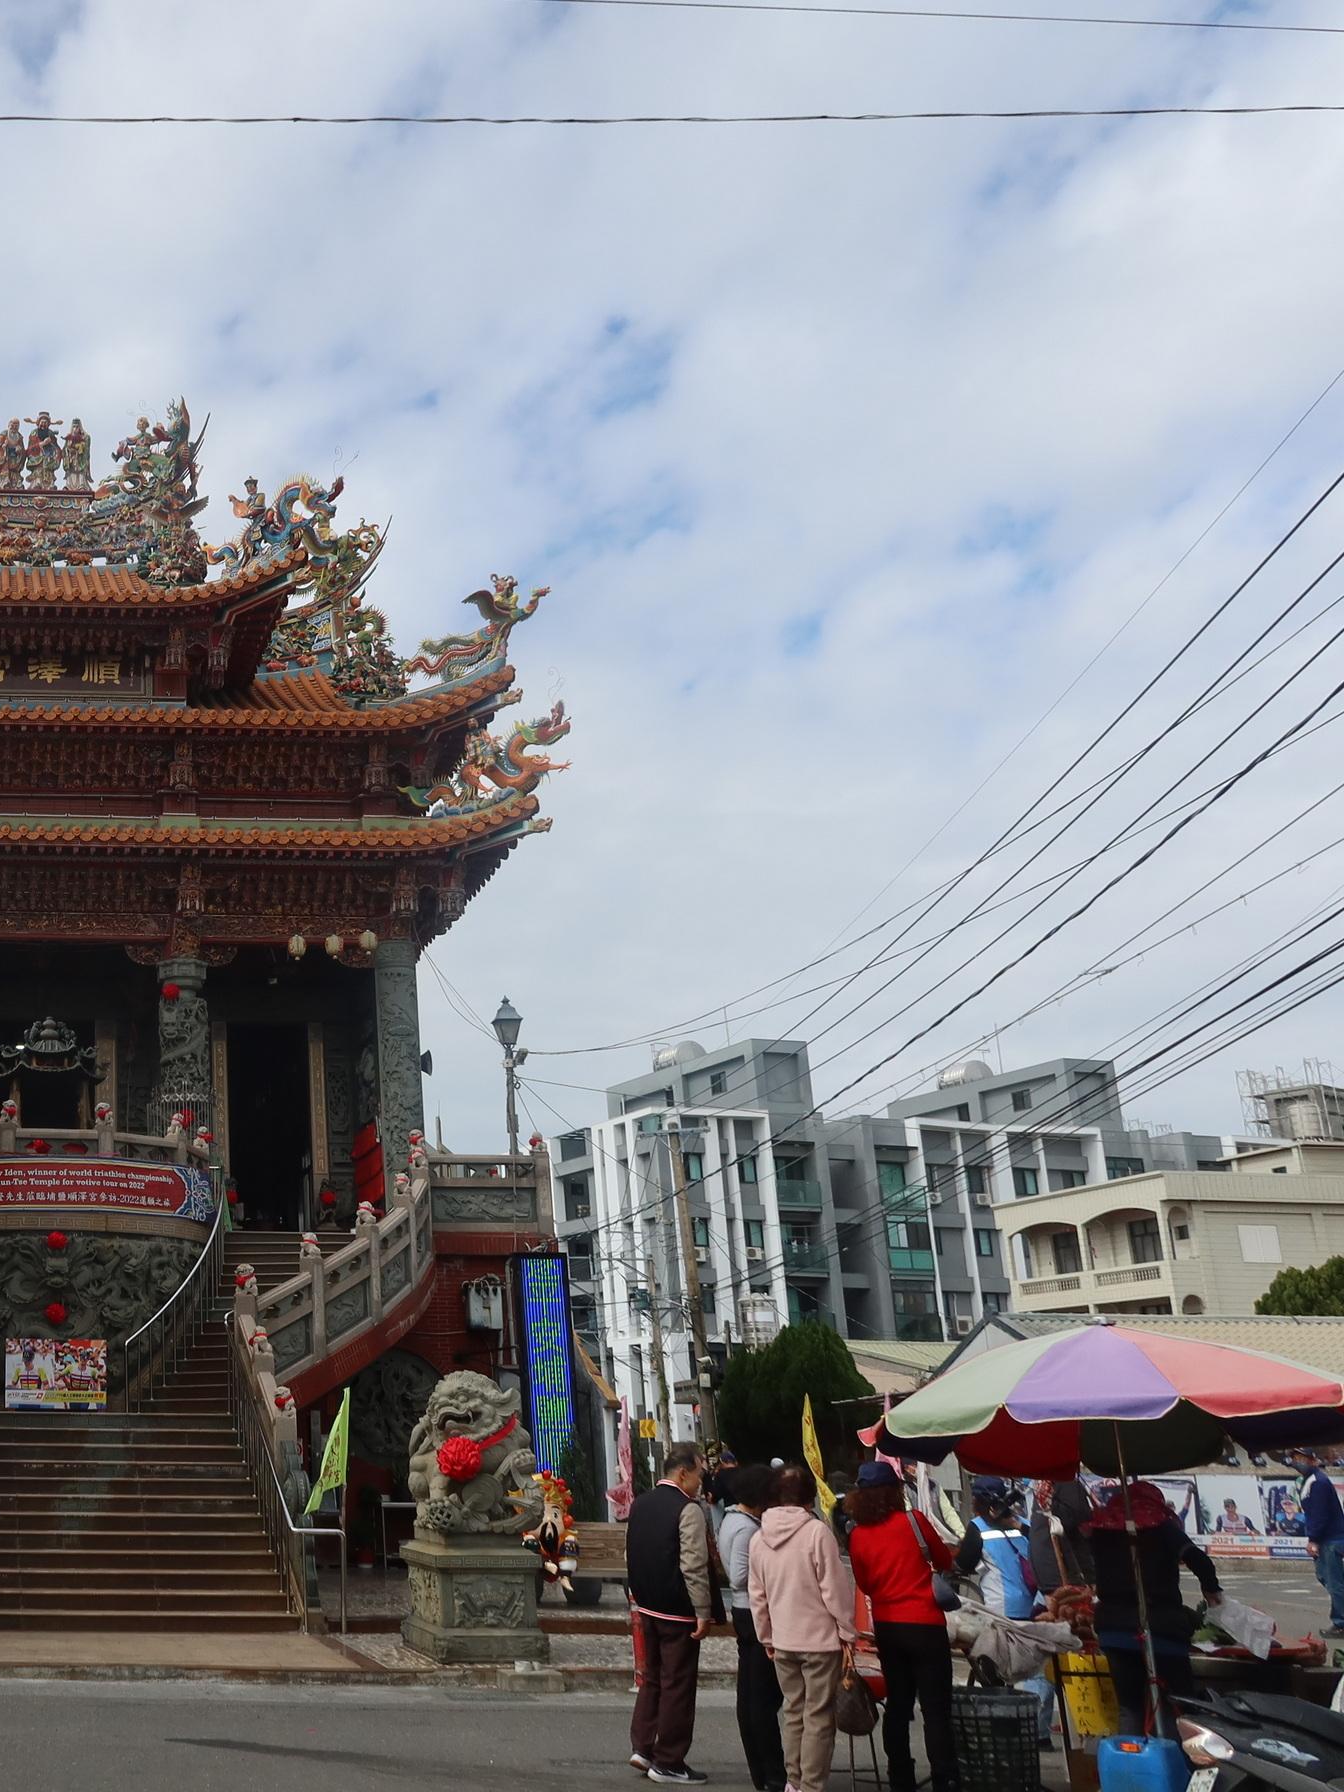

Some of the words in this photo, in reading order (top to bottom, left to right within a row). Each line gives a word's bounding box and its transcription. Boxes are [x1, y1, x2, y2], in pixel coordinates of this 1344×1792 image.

[4, 1168, 26, 1177] Iden,
[27, 1168, 57, 1177] winner
[59, 1168, 67, 1176] of
[68, 1168, 92, 1177] world
[94, 1168, 126, 1179] triathlon
[28, 1178, 61, 1188] Temple
[62, 1178, 74, 1186] for
[75, 1178, 101, 1187] votive
[102, 1179, 118, 1188] tour
[128, 1181, 145, 1190] 2022
